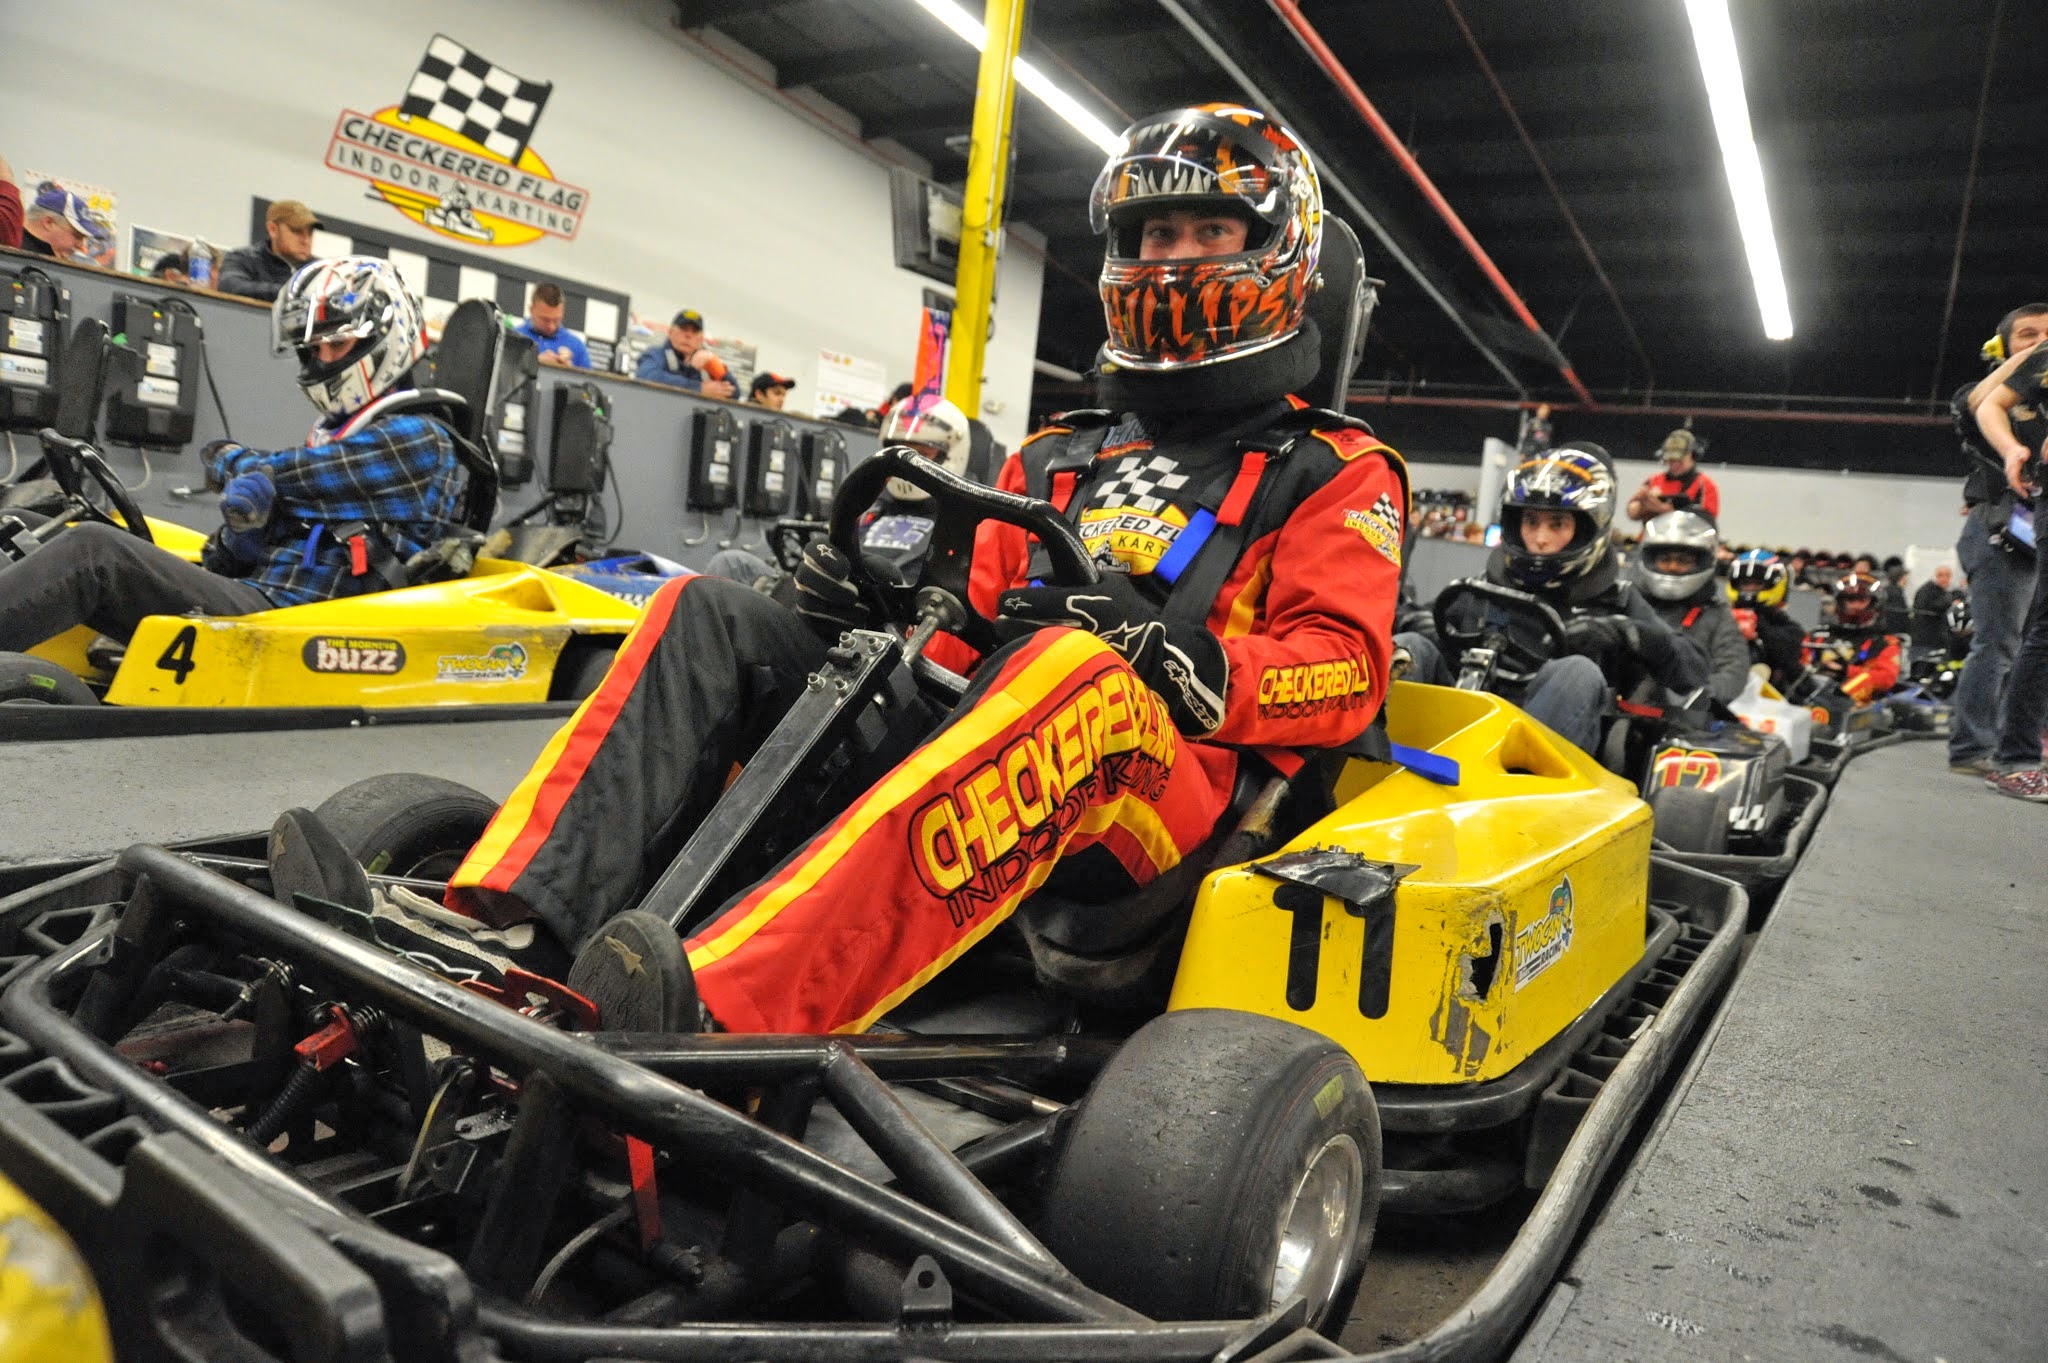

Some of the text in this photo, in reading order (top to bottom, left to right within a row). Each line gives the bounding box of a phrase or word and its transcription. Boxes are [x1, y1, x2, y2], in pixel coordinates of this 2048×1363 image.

[338, 145, 574, 234] INDOOR KARTING
[343, 118, 584, 212] CHECKERED FLAG
[156, 625, 197, 685] 4
[316, 639, 398, 672] buzz
[326, 639, 398, 652] THE MORNING
[1273, 884, 1396, 1020] 11
[1516, 912, 1562, 967] TWOCAN
[1540, 939, 1562, 966] RACING
